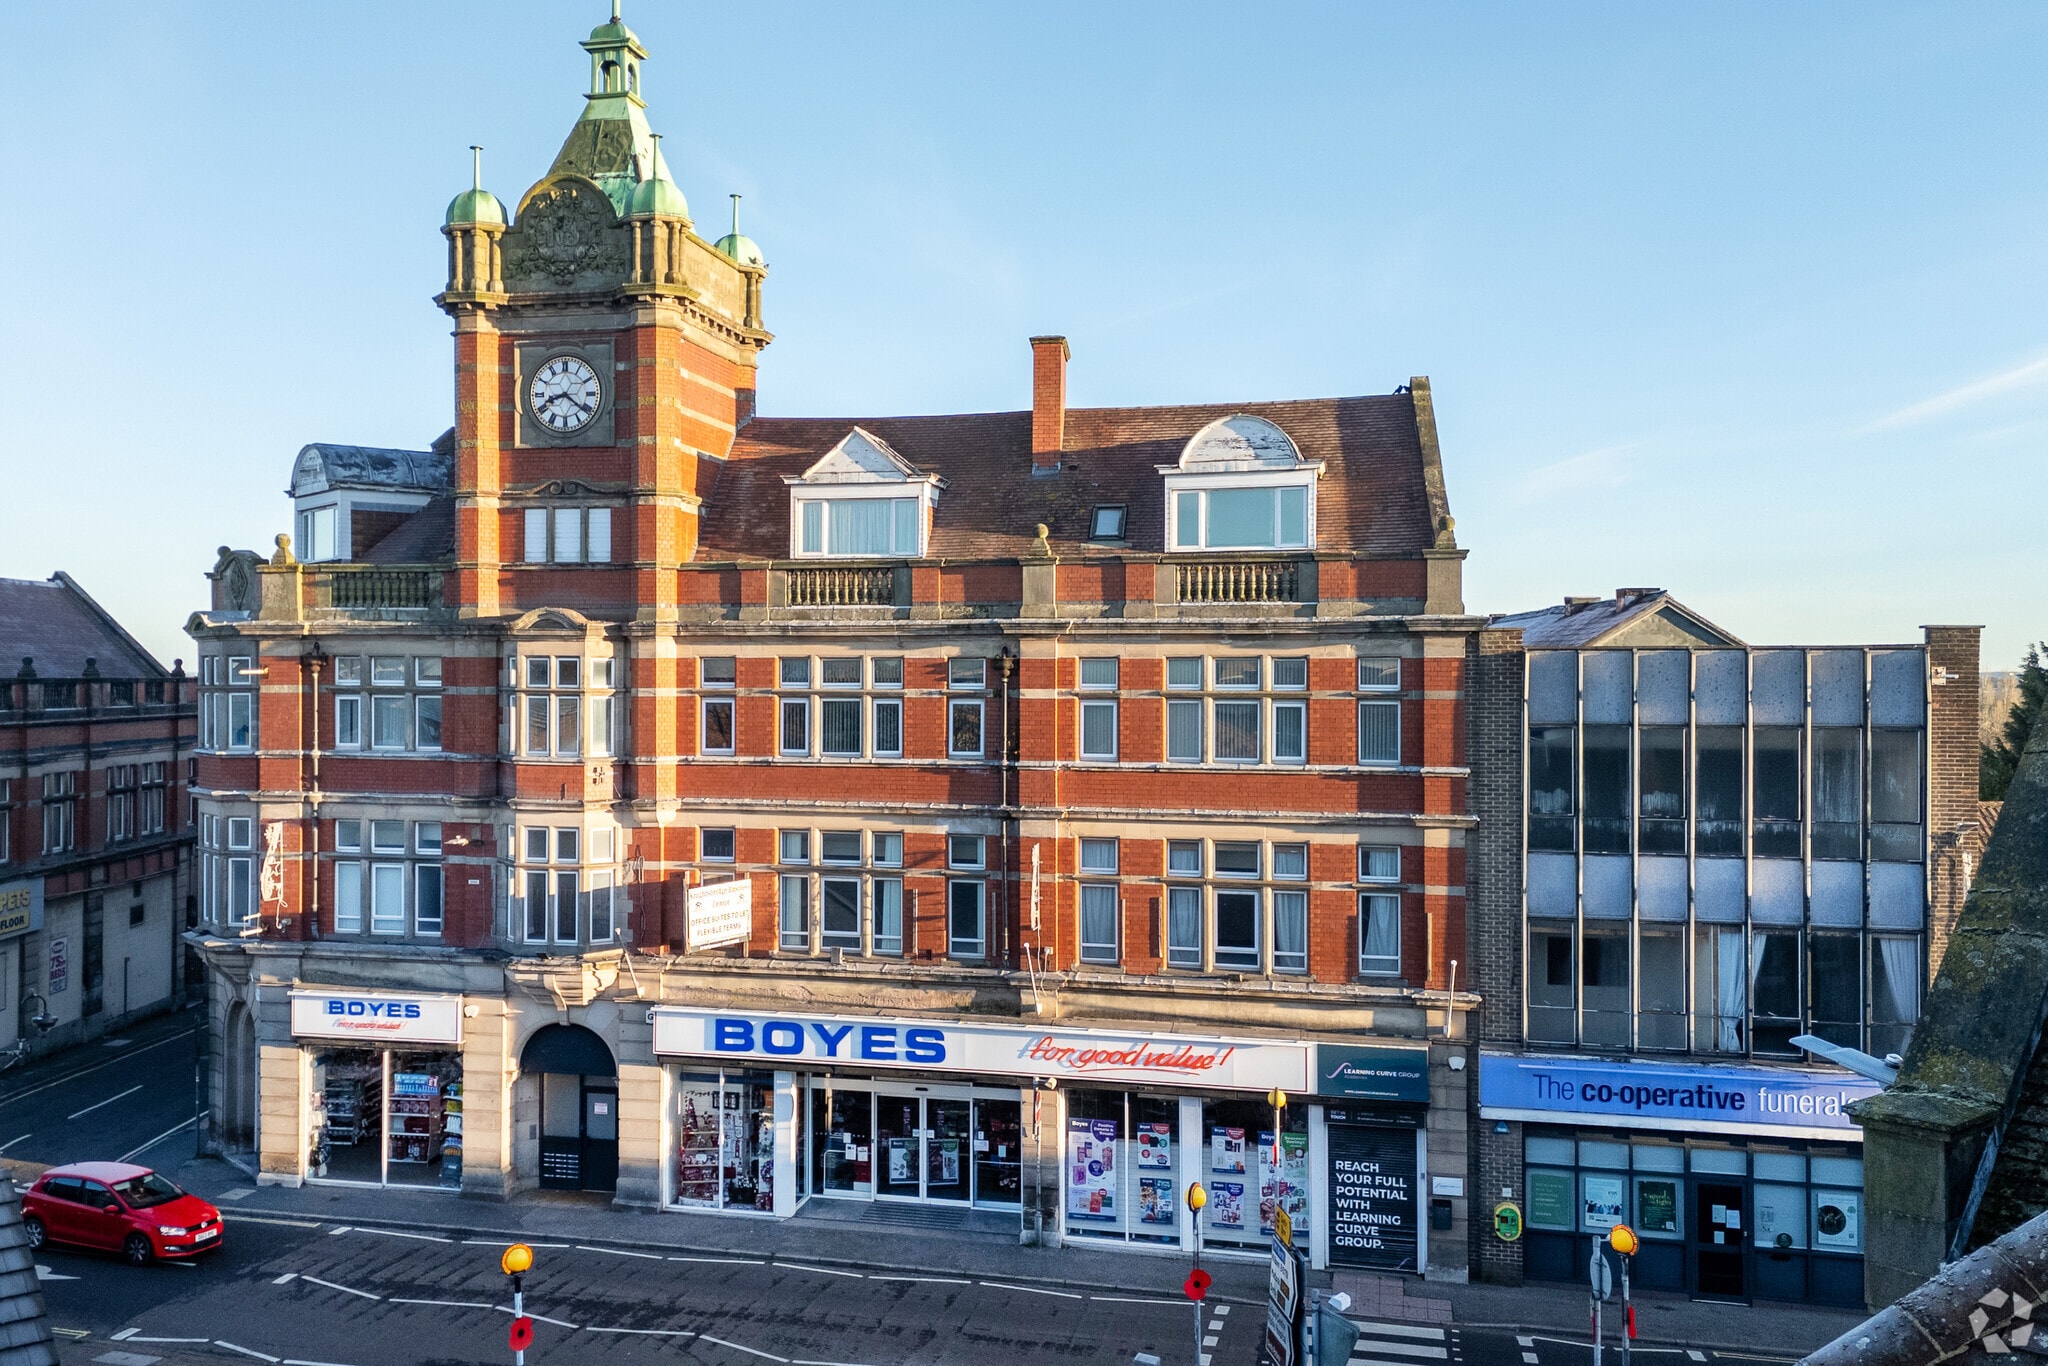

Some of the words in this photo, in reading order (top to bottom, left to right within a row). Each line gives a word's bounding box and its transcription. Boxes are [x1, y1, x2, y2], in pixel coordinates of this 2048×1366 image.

[1, 916, 25, 930] FLOOR
[691, 917, 710, 926] OFFICE
[711, 912, 731, 923] SUITES
[731, 911, 739, 919] TO
[328, 1000, 420, 1018] BOYES
[715, 1018, 946, 1063] BOYES
[1030, 1036, 1075, 1061] for
[1070, 1042, 1149, 1068] good
[1533, 1074, 1575, 1100] The
[1581, 1082, 1746, 1110] co-operative
[1336, 1161, 1379, 1173] REACH
[1336, 1173, 1371, 1185] YOUR
[1375, 1176, 1407, 1188] FULL
[1336, 1186, 1407, 1201] POTENTIAL
[1336, 1198, 1370, 1210] WITH
[1336, 1211, 1401, 1225] LEARNING
[1336, 1223, 1379, 1236] CURVE
[1336, 1236, 1384, 1249] GROUP.
